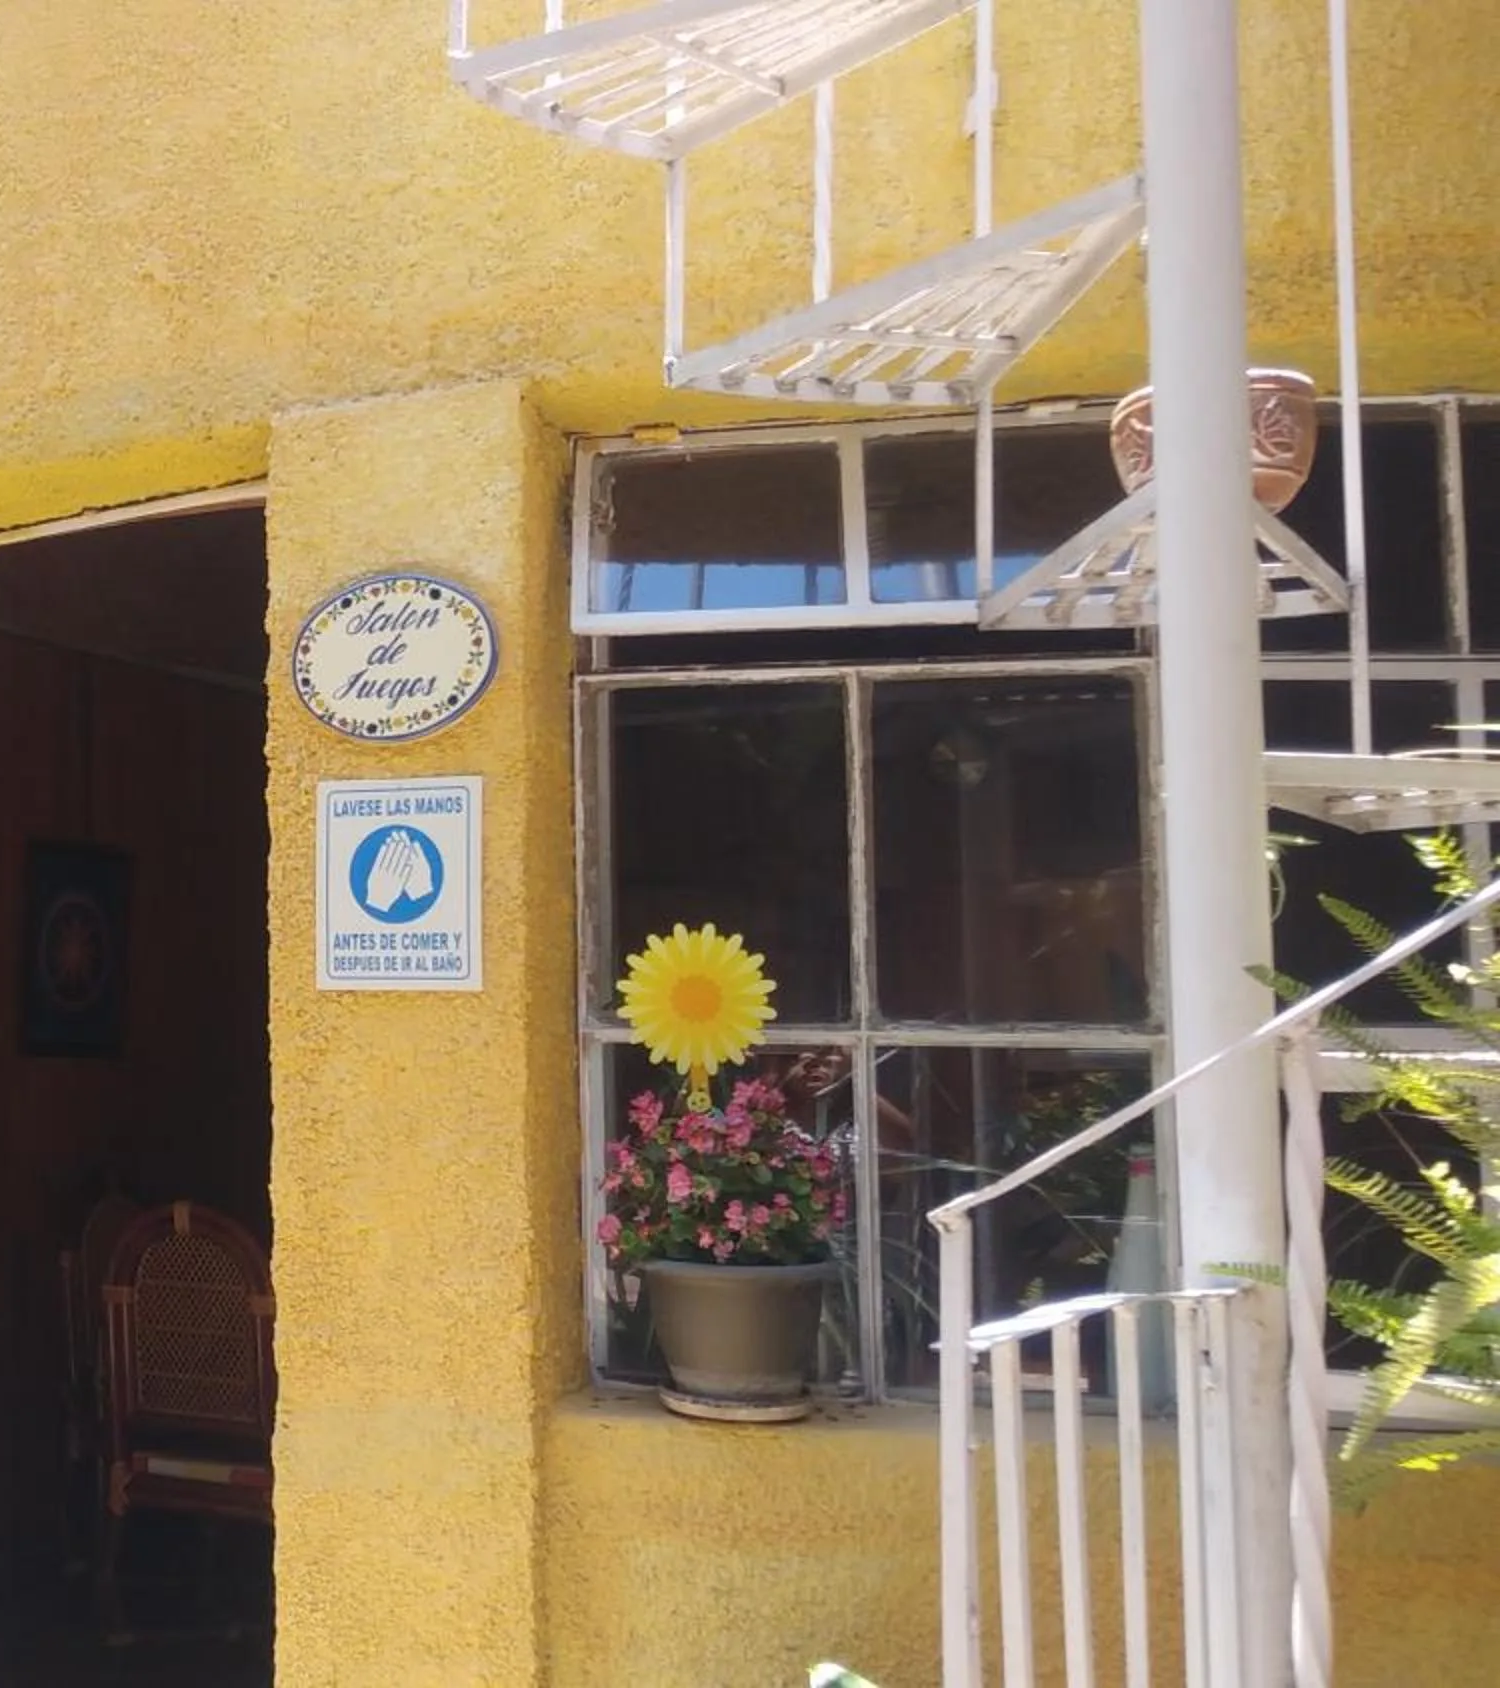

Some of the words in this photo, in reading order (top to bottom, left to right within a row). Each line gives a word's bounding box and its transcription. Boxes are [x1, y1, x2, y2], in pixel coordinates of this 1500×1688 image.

[367, 633, 408, 666] de
[333, 668, 437, 710] Juegos
[333, 800, 382, 817] LAVESE
[386, 798, 411, 816] LAS
[415, 796, 463, 814] MANOS
[333, 932, 376, 950] ANTES
[380, 932, 397, 950] DE
[401, 932, 449, 950] COMER
[453, 932, 463, 949] Y
[333, 956, 381, 972] DESPUES
[384, 956, 398, 971] DE
[401, 956, 412, 971] IR
[415, 956, 429, 971] AL
[432, 951, 463, 972] BAÑO
